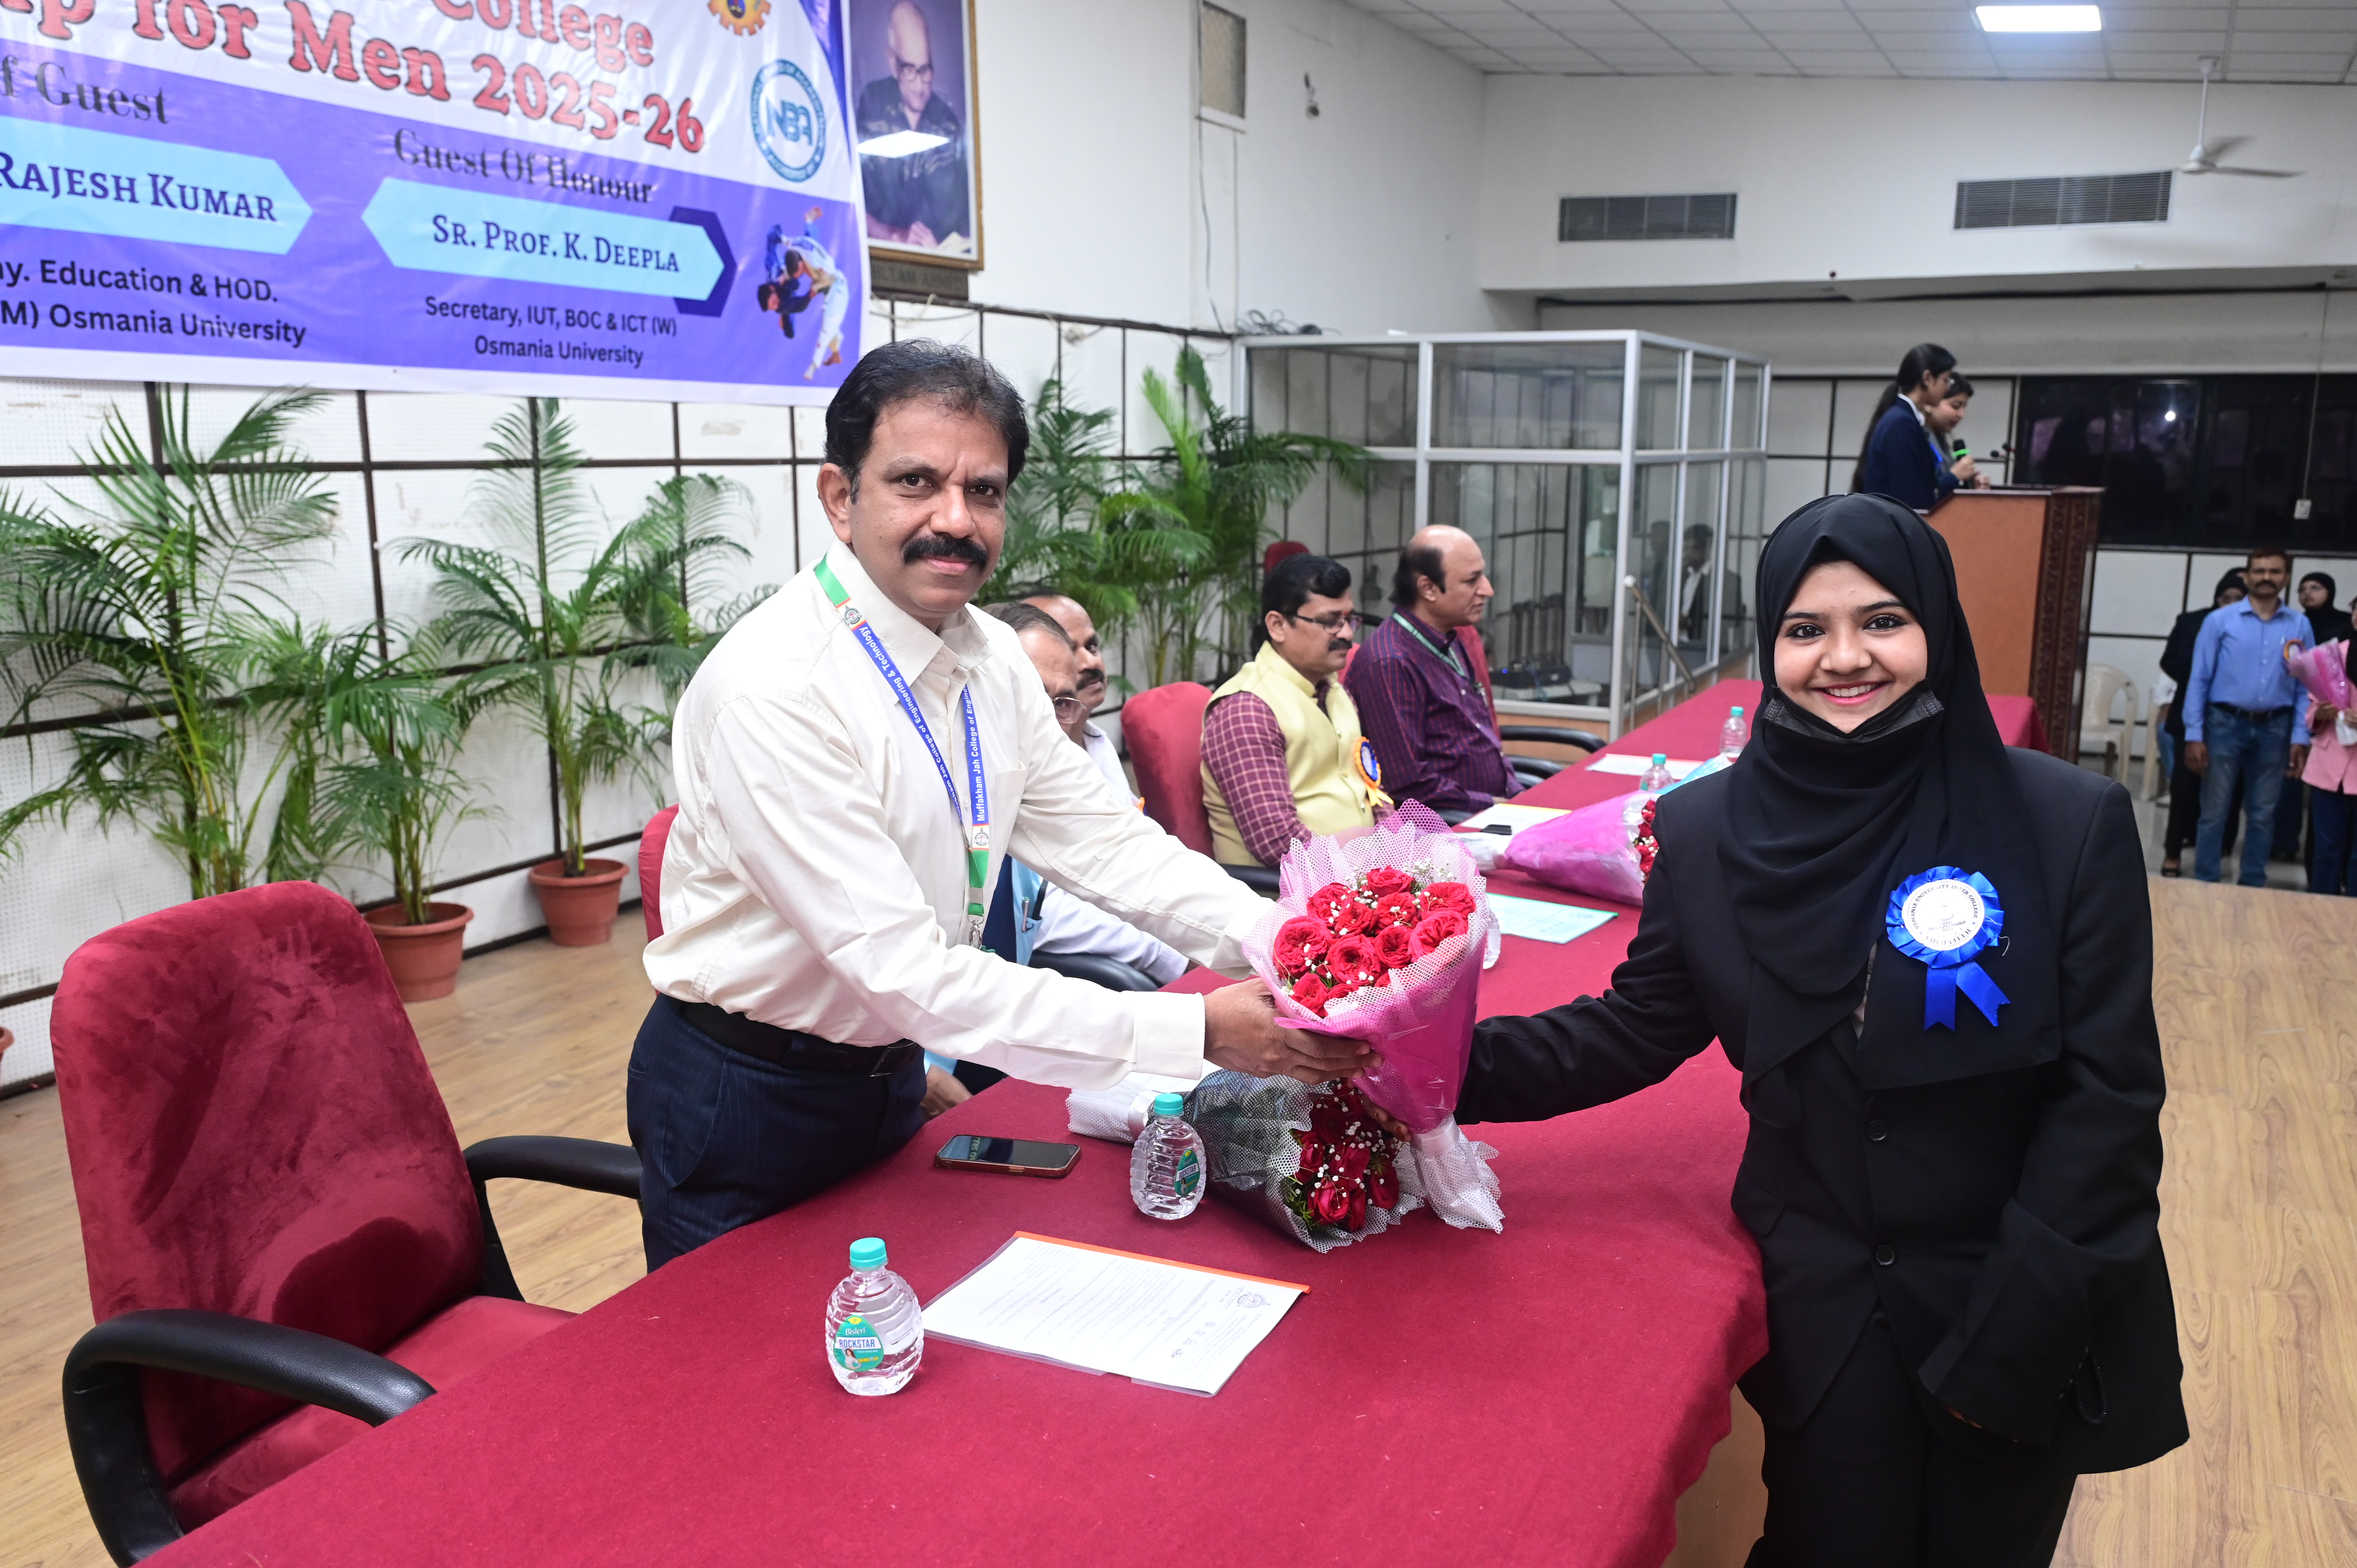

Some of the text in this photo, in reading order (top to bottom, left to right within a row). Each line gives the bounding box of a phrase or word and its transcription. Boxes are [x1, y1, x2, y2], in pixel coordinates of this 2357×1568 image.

[35, 62, 168, 124] Guest
[284, 0, 451, 101] Men
[472, 54, 704, 153] 2025-26
[766, 97, 813, 146] NBA
[394, 129, 652, 203] Guest Of Honour
[148, 173, 277, 222] KUMAR
[564, 232, 588, 260] K.
[595, 237, 680, 273] DEEPLA
[41, 260, 182, 295] Education
[190, 275, 207, 297] &
[215, 279, 278, 302] HOD.
[49, 304, 173, 334] Osmania
[182, 315, 306, 347] University
[426, 296, 677, 337] Secretary, IUT, BOC & ICT (W)
[475, 335, 644, 369] Osmania University
[859, 627, 891, 671] Technology
[894, 677, 921, 724] Engineering
[968, 716, 974, 724] of
[918, 724, 927, 733] of
[925, 734, 941, 763] College
[970, 727, 979, 757] College
[975, 776, 985, 821] Muffakham
[1915, 884, 1949, 902] UNIVERSITY
[1951, 885, 1978, 918] INTER-COLLEGE
[839, 1339, 875, 1348] ROCKSTAR
[845, 1326, 865, 1335] Bisleri
